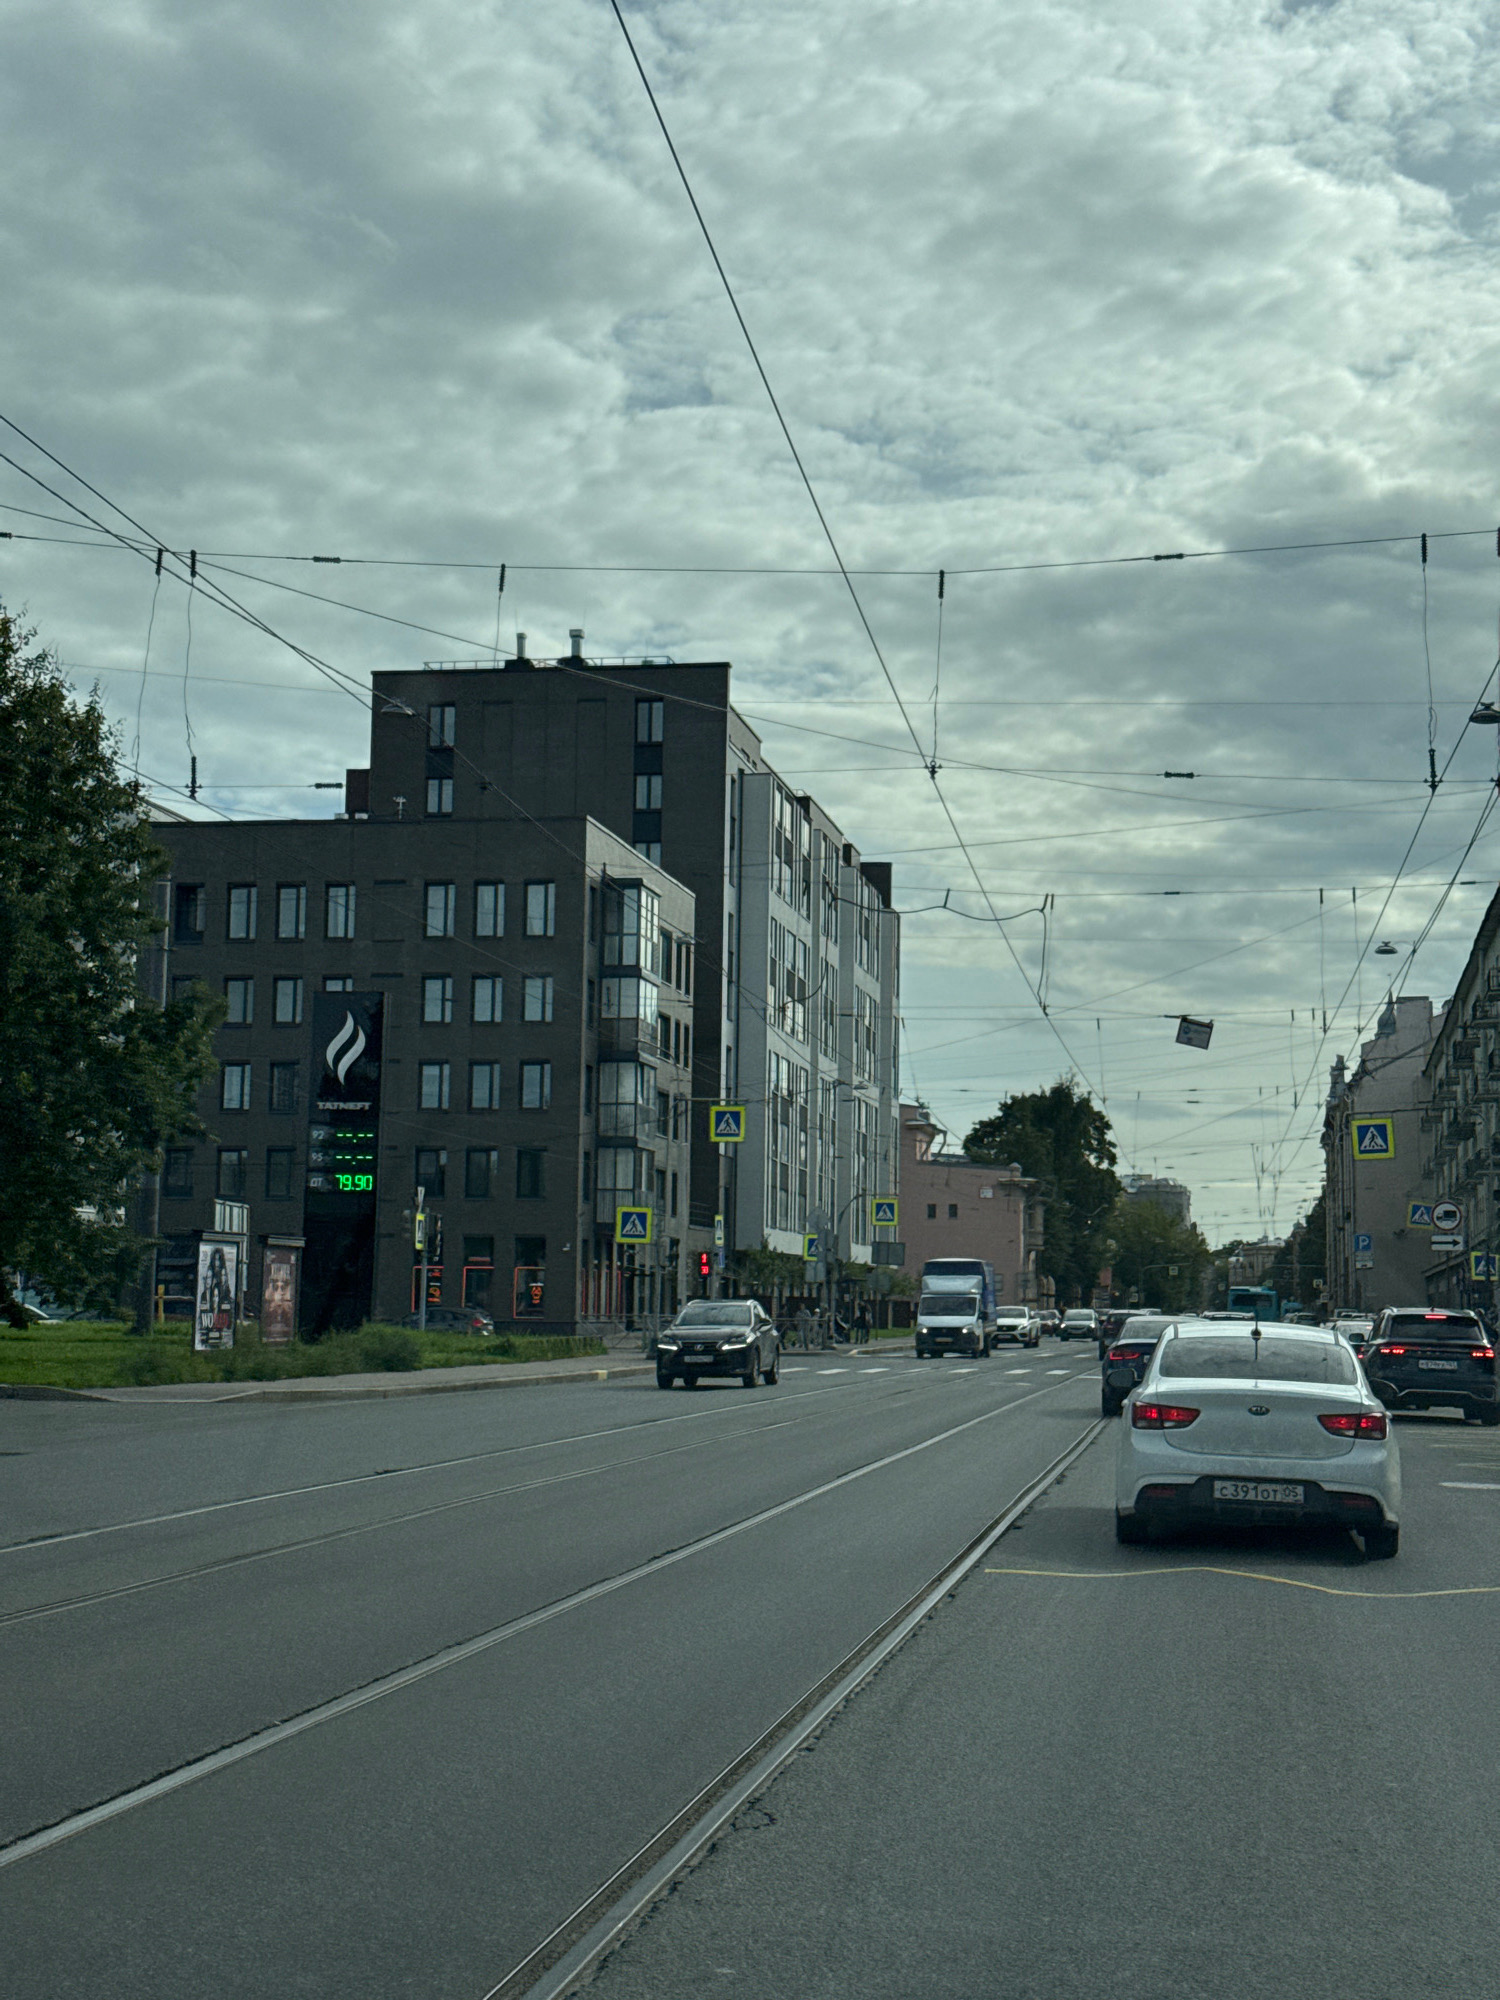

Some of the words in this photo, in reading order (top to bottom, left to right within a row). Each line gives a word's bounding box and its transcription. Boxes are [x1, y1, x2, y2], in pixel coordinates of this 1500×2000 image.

[317, 1102, 372, 1110] TATNEFT
[312, 1130, 324, 1140] 92
[311, 1152, 323, 1162] 95
[335, 1174, 373, 1191] 79.90
